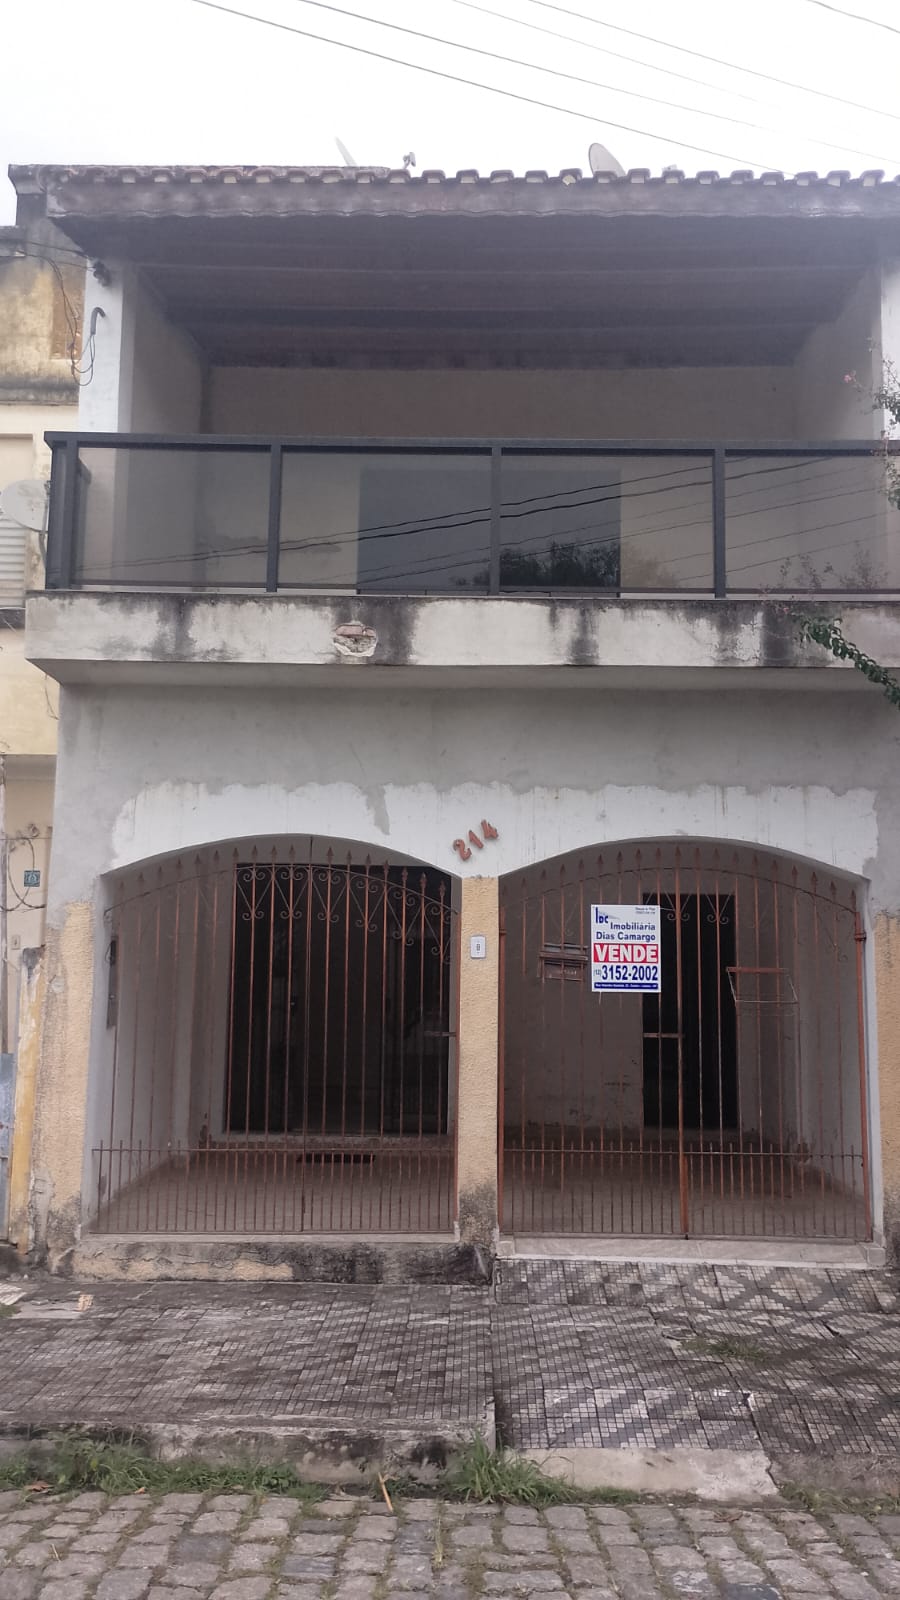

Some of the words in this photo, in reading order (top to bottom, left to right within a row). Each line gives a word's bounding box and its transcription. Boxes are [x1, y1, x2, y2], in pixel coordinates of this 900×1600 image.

[452, 819, 499, 861] 214
[596, 931, 615, 940] Dias
[617, 931, 656, 943] Camargo
[595, 945, 658, 962] VENDE
[602, 965, 658, 981] 3152-2002
